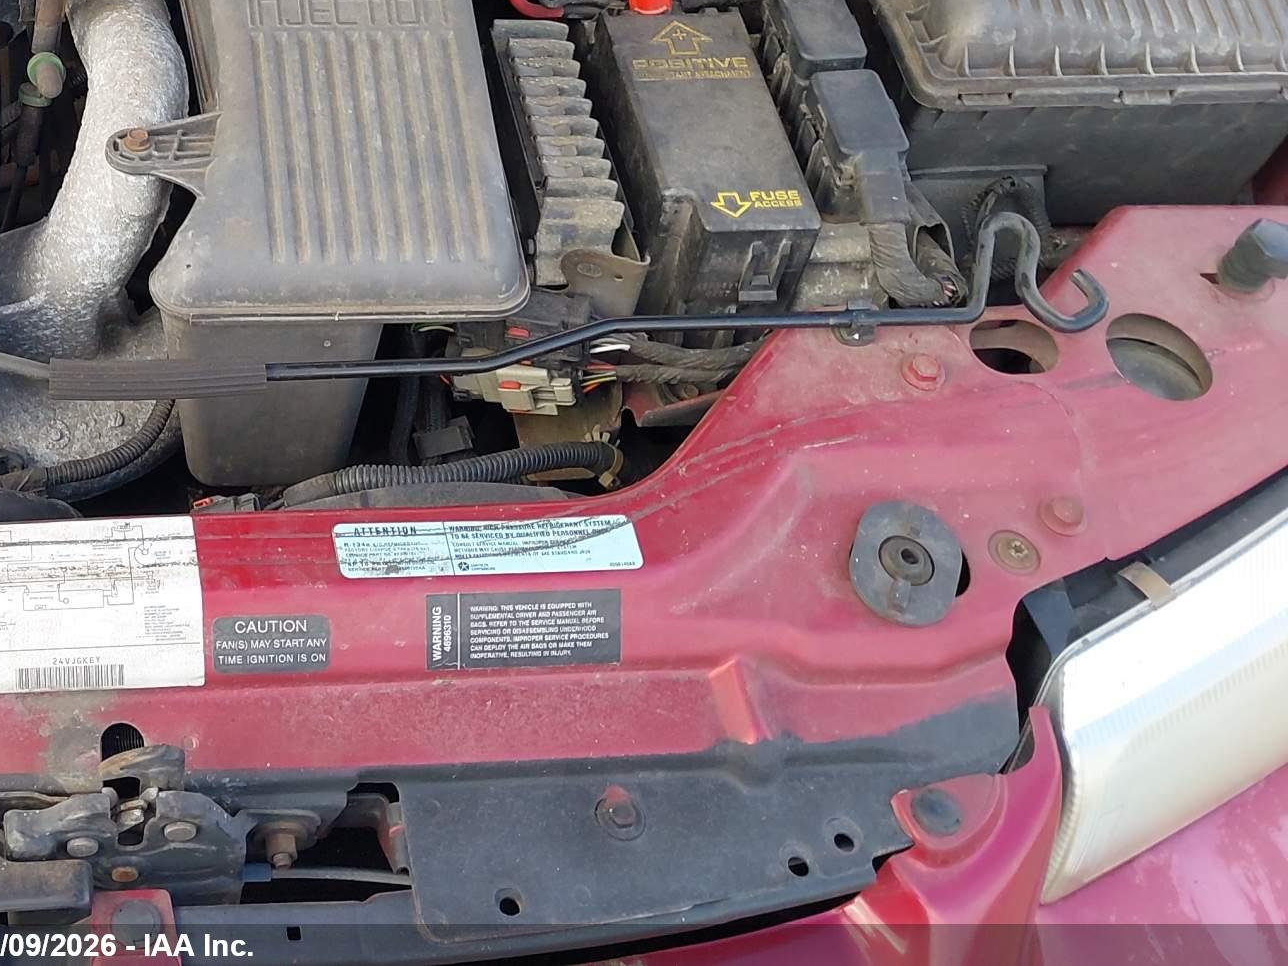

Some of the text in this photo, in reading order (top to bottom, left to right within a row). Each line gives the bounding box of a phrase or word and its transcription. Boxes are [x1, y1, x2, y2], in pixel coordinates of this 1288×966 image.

[632, 57, 749, 69] POSITIVE
[749, 190, 801, 202] FUSE
[754, 199, 803, 208] ACCESS
[583, 519, 611, 527] SYSTEM
[353, 525, 418, 536] ATTENTION
[234, 619, 308, 634] CAUTION
[512, 626, 559, 635] DISASSEMBLING
[432, 605, 442, 662] WARNING
[443, 614, 452, 652] 4696310
[513, 634, 543, 642] IMPROPER
[215, 637, 327, 651] FAN(S) MAY START ANY
[217, 653, 327, 665] TIME IGNITION IS ON
[510, 650, 542, 658] RESULTING
